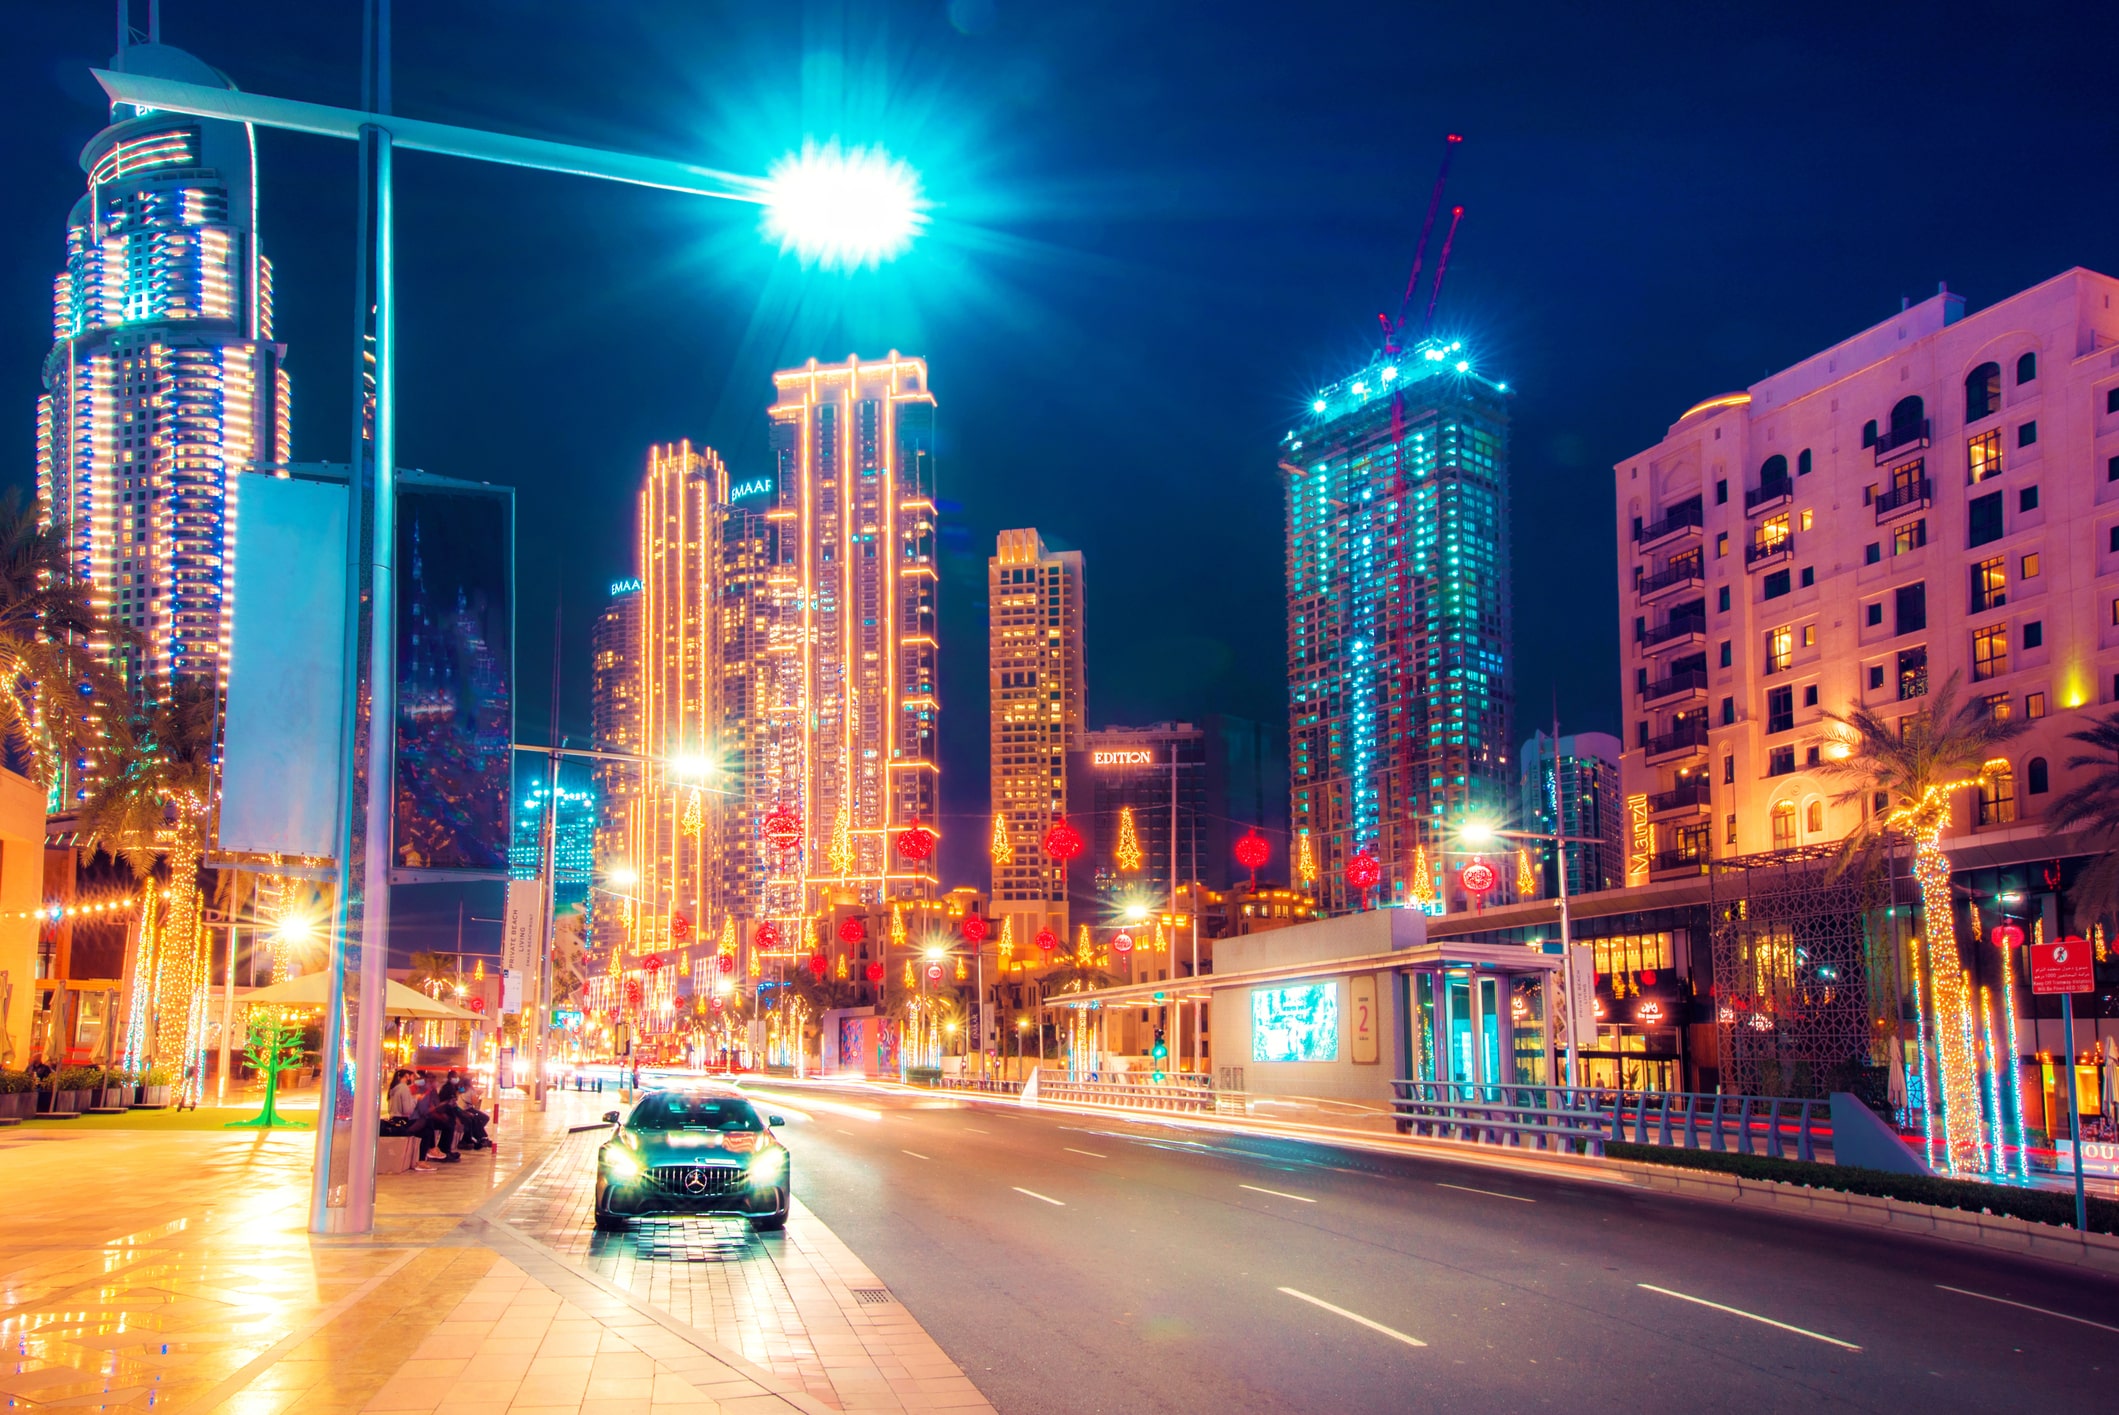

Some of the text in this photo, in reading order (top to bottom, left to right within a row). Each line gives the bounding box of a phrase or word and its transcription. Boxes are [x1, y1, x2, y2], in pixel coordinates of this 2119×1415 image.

[1094, 751, 1151, 765] EDITION
[509, 937, 517, 969] PRIVATE
[1359, 1005, 1369, 1033] 2
